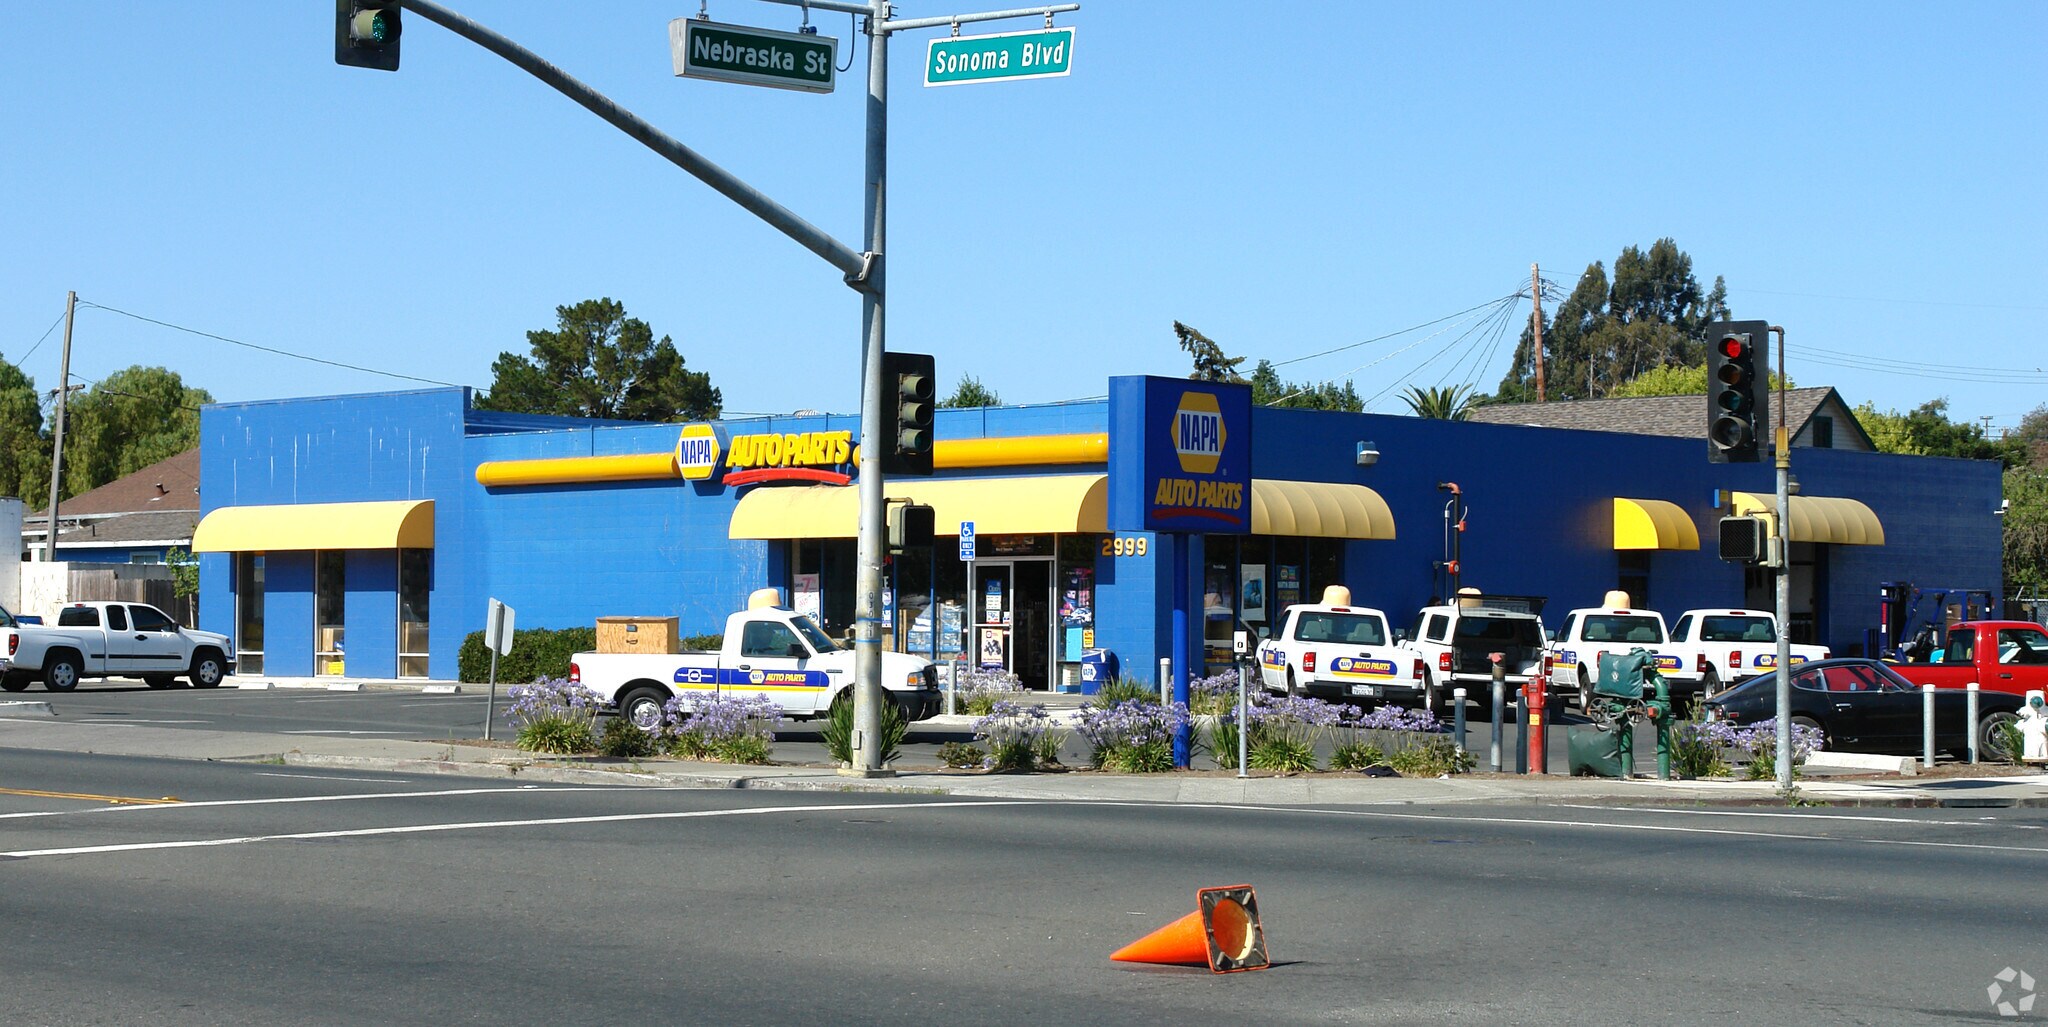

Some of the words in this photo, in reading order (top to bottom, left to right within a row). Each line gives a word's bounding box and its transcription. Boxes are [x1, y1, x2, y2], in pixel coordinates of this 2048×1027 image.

[693, 35, 795, 72] Nebraska
[803, 49, 827, 75] St
[934, 47, 1010, 75] Sonoma
[1021, 39, 1065, 67] Blvd
[1180, 413, 1219, 452] NAPA
[681, 439, 711, 465] NAPA
[1154, 478, 1196, 507] AUTO
[1197, 481, 1243, 511] PARTS
[1101, 537, 1147, 557] 2999
[765, 673, 784, 682] AUTO
[784, 673, 806, 682] PARTS
[1353, 661, 1371, 670] AUTO
[1370, 662, 1391, 671] PARTS
